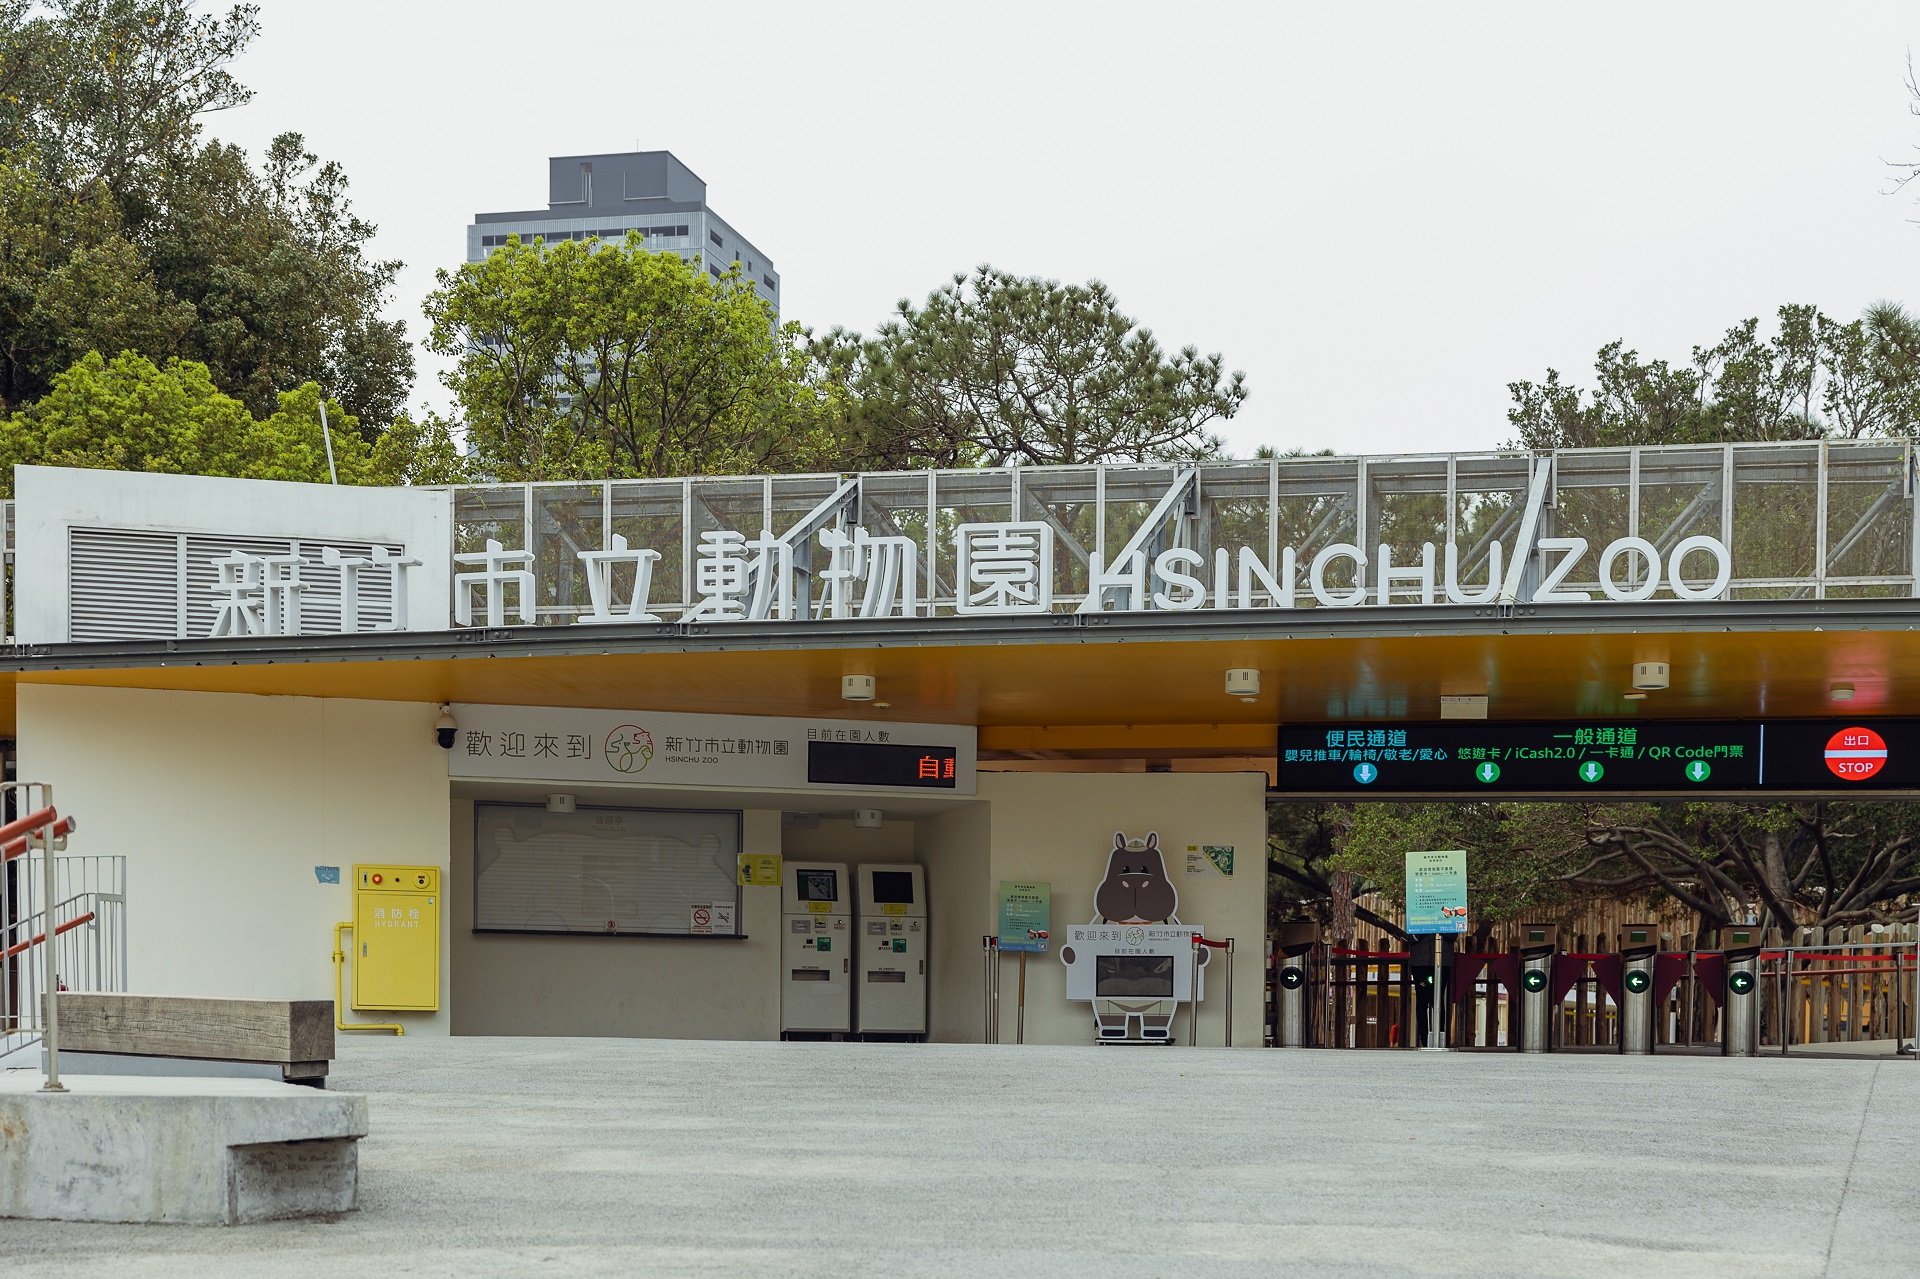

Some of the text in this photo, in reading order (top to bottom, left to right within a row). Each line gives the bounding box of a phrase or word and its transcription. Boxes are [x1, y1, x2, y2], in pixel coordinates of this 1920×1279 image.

[208, 520, 1731, 637] 新竹市立動物園 HSINCHU ZOO
[807, 728, 890, 743] 目前在園人數
[1325, 729, 1407, 747] 便民通道
[1552, 727, 1638, 745] 一般通道
[1844, 735, 1869, 746] 出口
[465, 730, 592, 760] 歡迎來到
[666, 736, 789, 756] 新竹市立動物園
[1284, 748, 1448, 762] 嬰兒推車/輪椅/敬老/愛心
[1457, 747, 1501, 760] 悠遊卡
[1515, 746, 1575, 759] iCash2.0
[1588, 746, 1634, 759] 一卡通
[1648, 746, 1672, 759] QR
[1838, 762, 1874, 773] STOP
[373, 907, 421, 919] 消防栓
[1074, 930, 1122, 942] 歡迎來到
